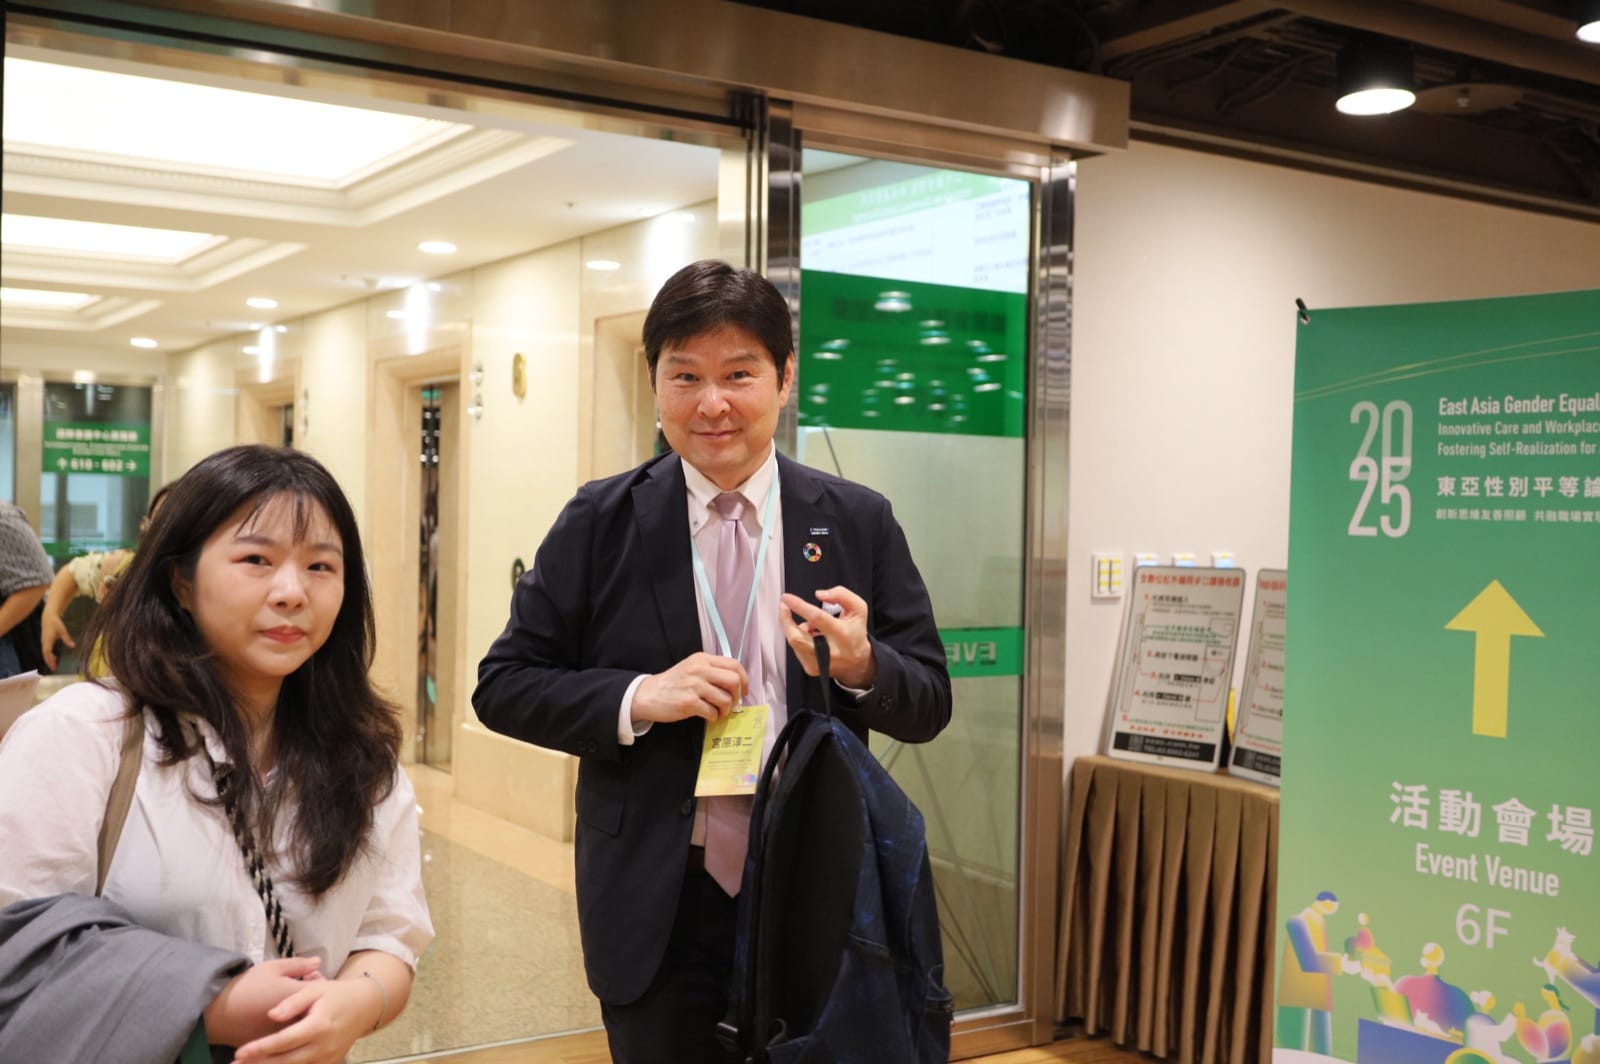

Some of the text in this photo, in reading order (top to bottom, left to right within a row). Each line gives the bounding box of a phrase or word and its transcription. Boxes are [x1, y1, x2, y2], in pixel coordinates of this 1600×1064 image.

[1439, 397, 1467, 416] East
[1471, 396, 1500, 415] Asia
[1504, 395, 1554, 414] Gender
[1438, 419, 1600, 437] Innovative Care and Workplac
[1438, 440, 1596, 459] Fostering Self-Realization for
[1348, 455, 1412, 538] 25
[1437, 475, 1600, 498] 東亞性別平等論
[1389, 781, 1594, 856] 活動會場
[1415, 842, 1560, 897] Event Venue
[1456, 903, 1512, 950] 6F
